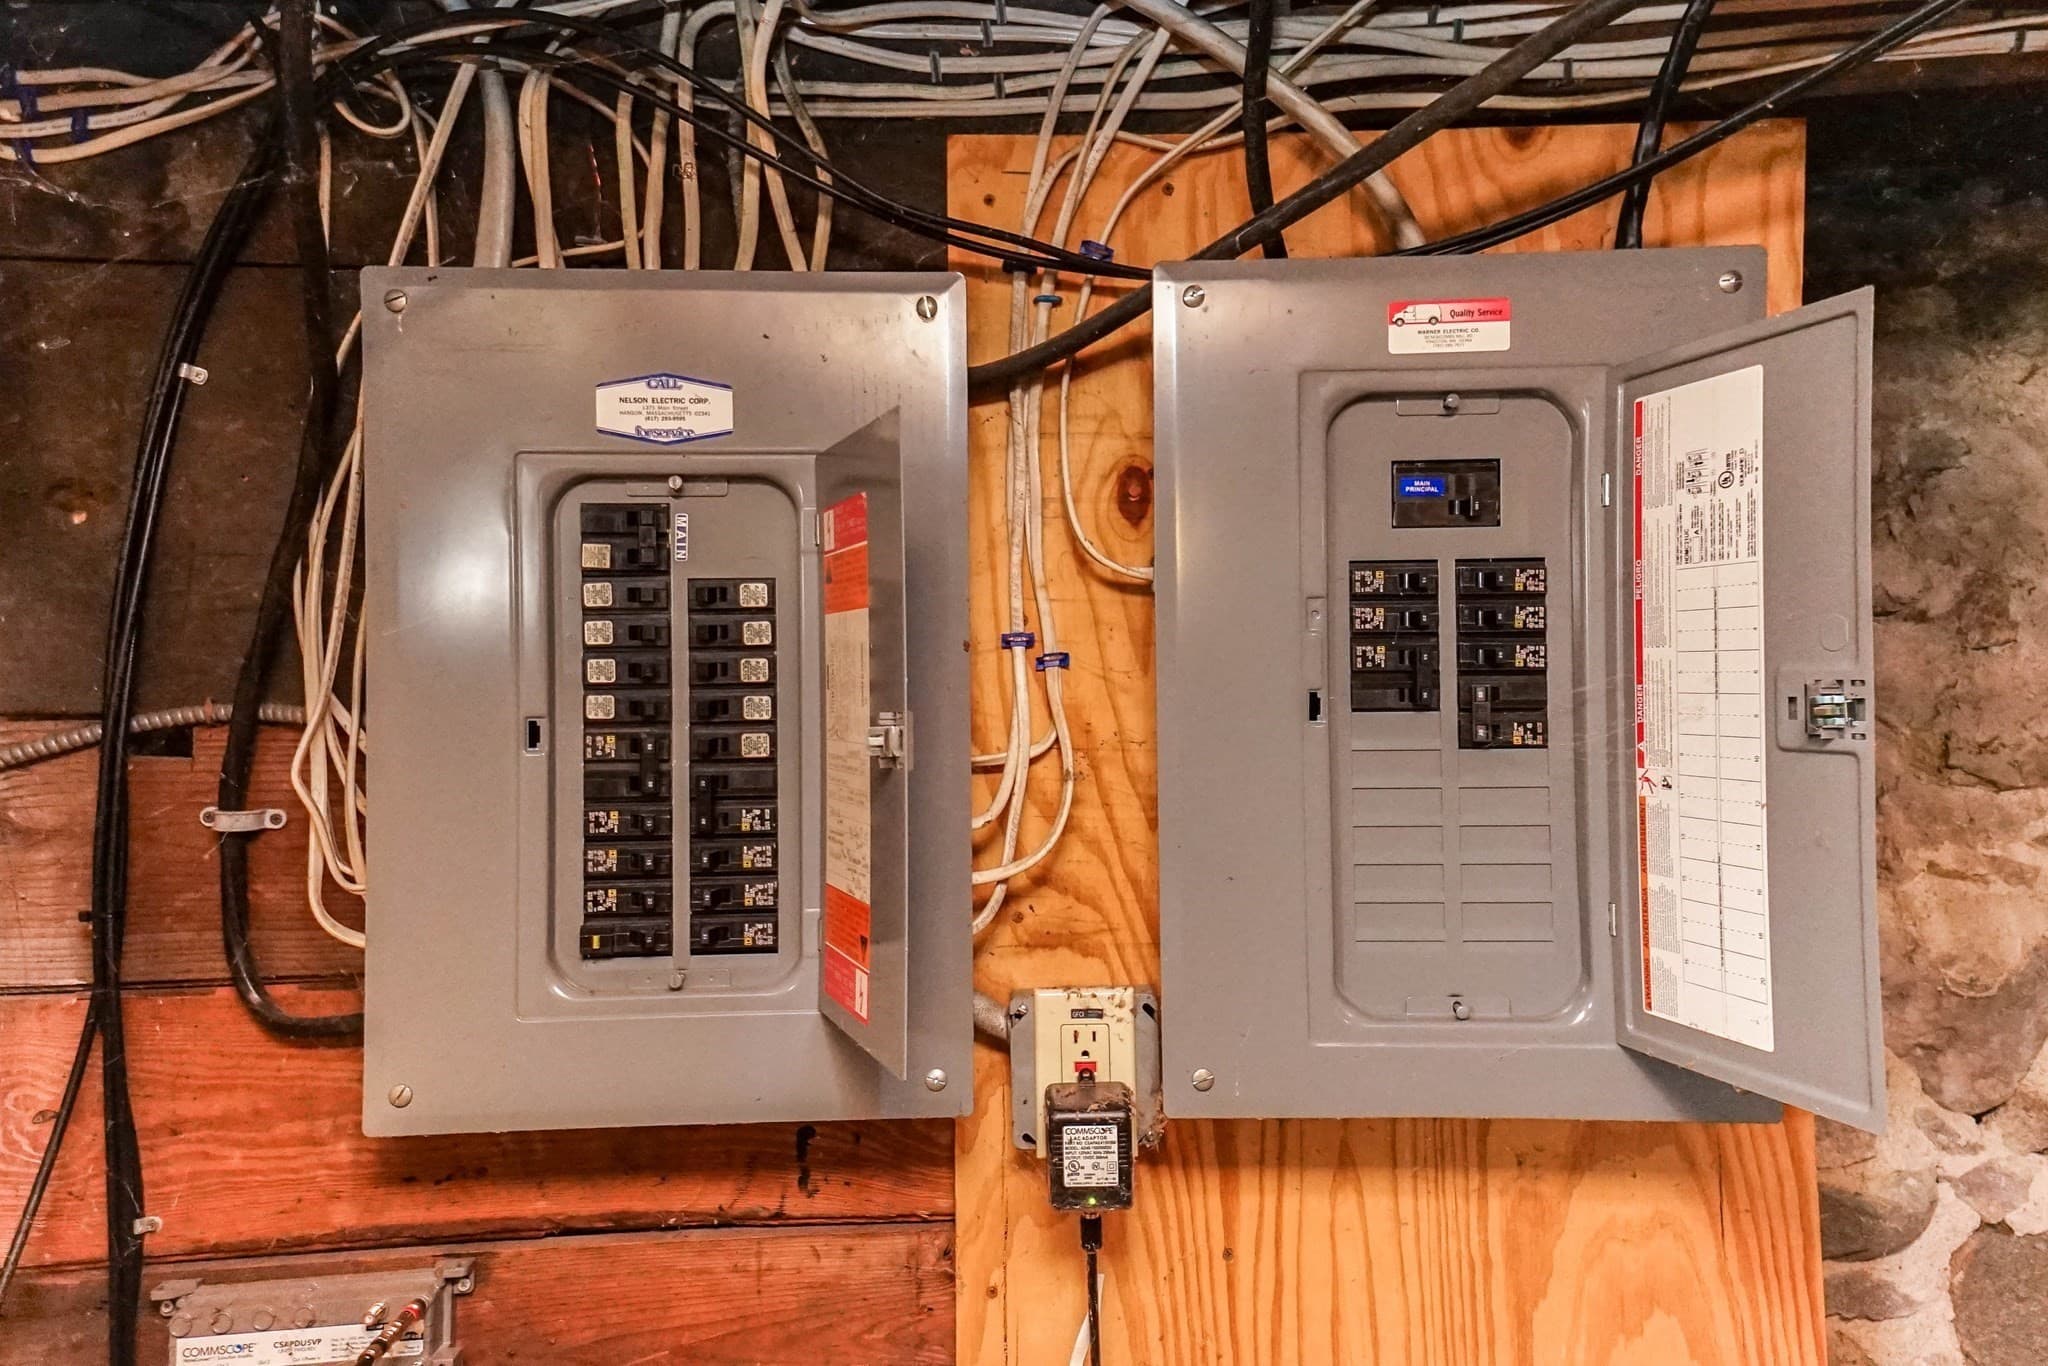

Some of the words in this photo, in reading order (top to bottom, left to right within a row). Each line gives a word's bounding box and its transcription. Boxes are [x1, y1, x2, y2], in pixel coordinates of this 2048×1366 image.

[1450, 309, 1475, 319] Quality
[1477, 308, 1503, 317] Service
[646, 379, 683, 389] CALL
[677, 514, 687, 560] MAIN
[1640, 802, 1648, 874] AVERTISSEMENT
[1641, 887, 1649, 949] ADVERTENCIA
[1644, 958, 1652, 1000] WARNING
[182, 1342, 254, 1358] COMMSCOPE
